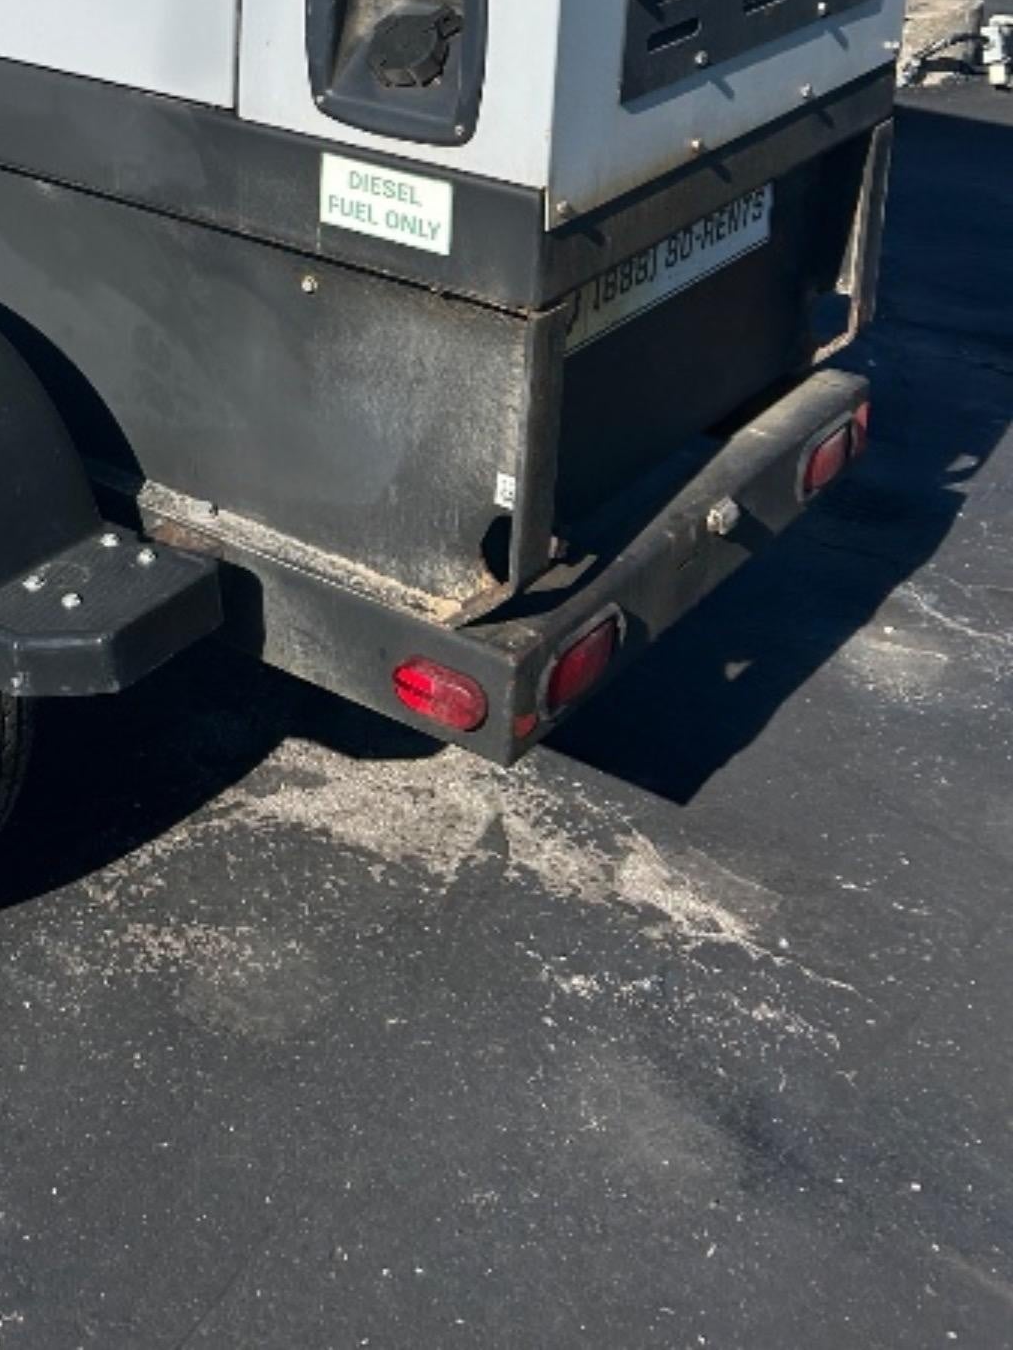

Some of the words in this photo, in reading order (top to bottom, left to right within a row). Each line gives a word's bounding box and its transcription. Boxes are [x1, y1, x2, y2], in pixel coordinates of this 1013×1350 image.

[349, 170, 422, 207] DIESEL
[328, 194, 378, 225] FUEL
[385, 210, 441, 240] ONLY
